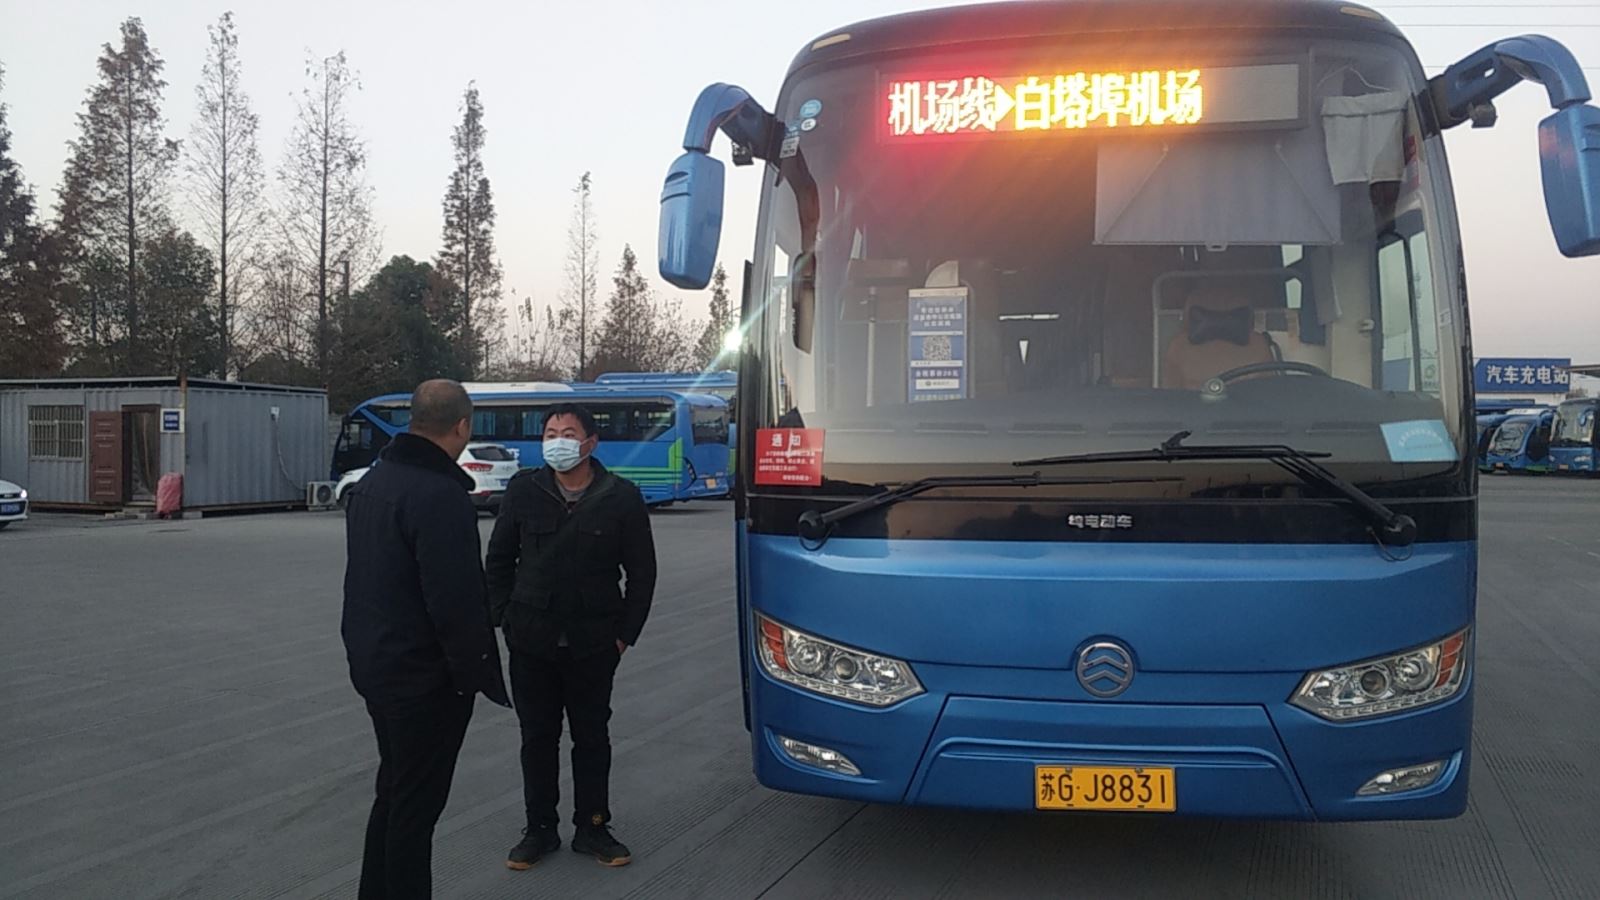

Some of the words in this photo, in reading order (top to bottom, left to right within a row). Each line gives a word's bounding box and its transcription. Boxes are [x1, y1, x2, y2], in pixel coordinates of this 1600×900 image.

[888, 77, 996, 135] 机场线
[1015, 70, 1202, 130] 白塔埠机场
[1487, 365, 1569, 384] 汽车充电站
[772, 433, 801, 447] 通知
[1068, 514, 1132, 529] 纯电动车
